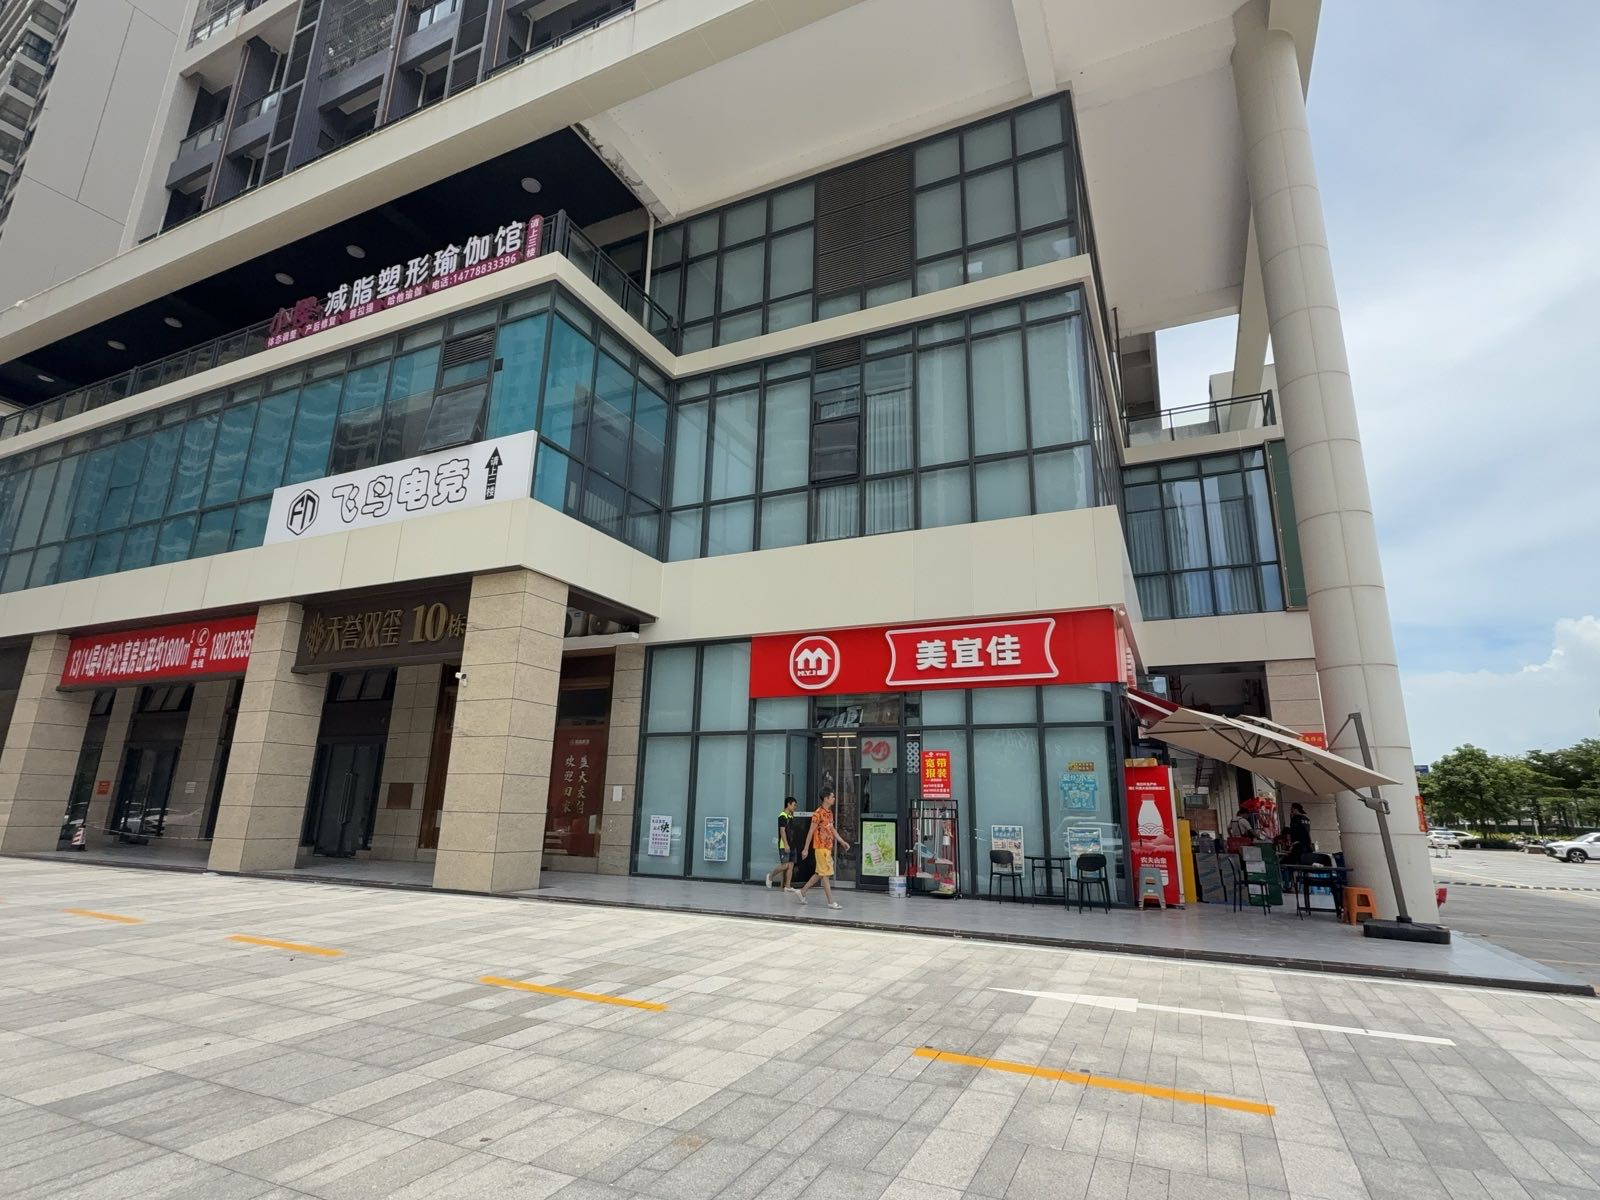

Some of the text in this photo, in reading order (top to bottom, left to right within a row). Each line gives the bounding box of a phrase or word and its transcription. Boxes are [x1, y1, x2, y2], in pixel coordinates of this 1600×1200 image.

[526, 217, 540, 258] 请上三楼
[324, 220, 525, 317] 减脂塑形瑜伽馆
[331, 458, 470, 523] 飞鸟电竞
[486, 455, 500, 498] 请上二楼
[324, 608, 404, 652] 天誉双玺
[916, 634, 1022, 671] 美宜佳
[925, 758, 947, 768] 宽带
[925, 768, 948, 778] 报装
